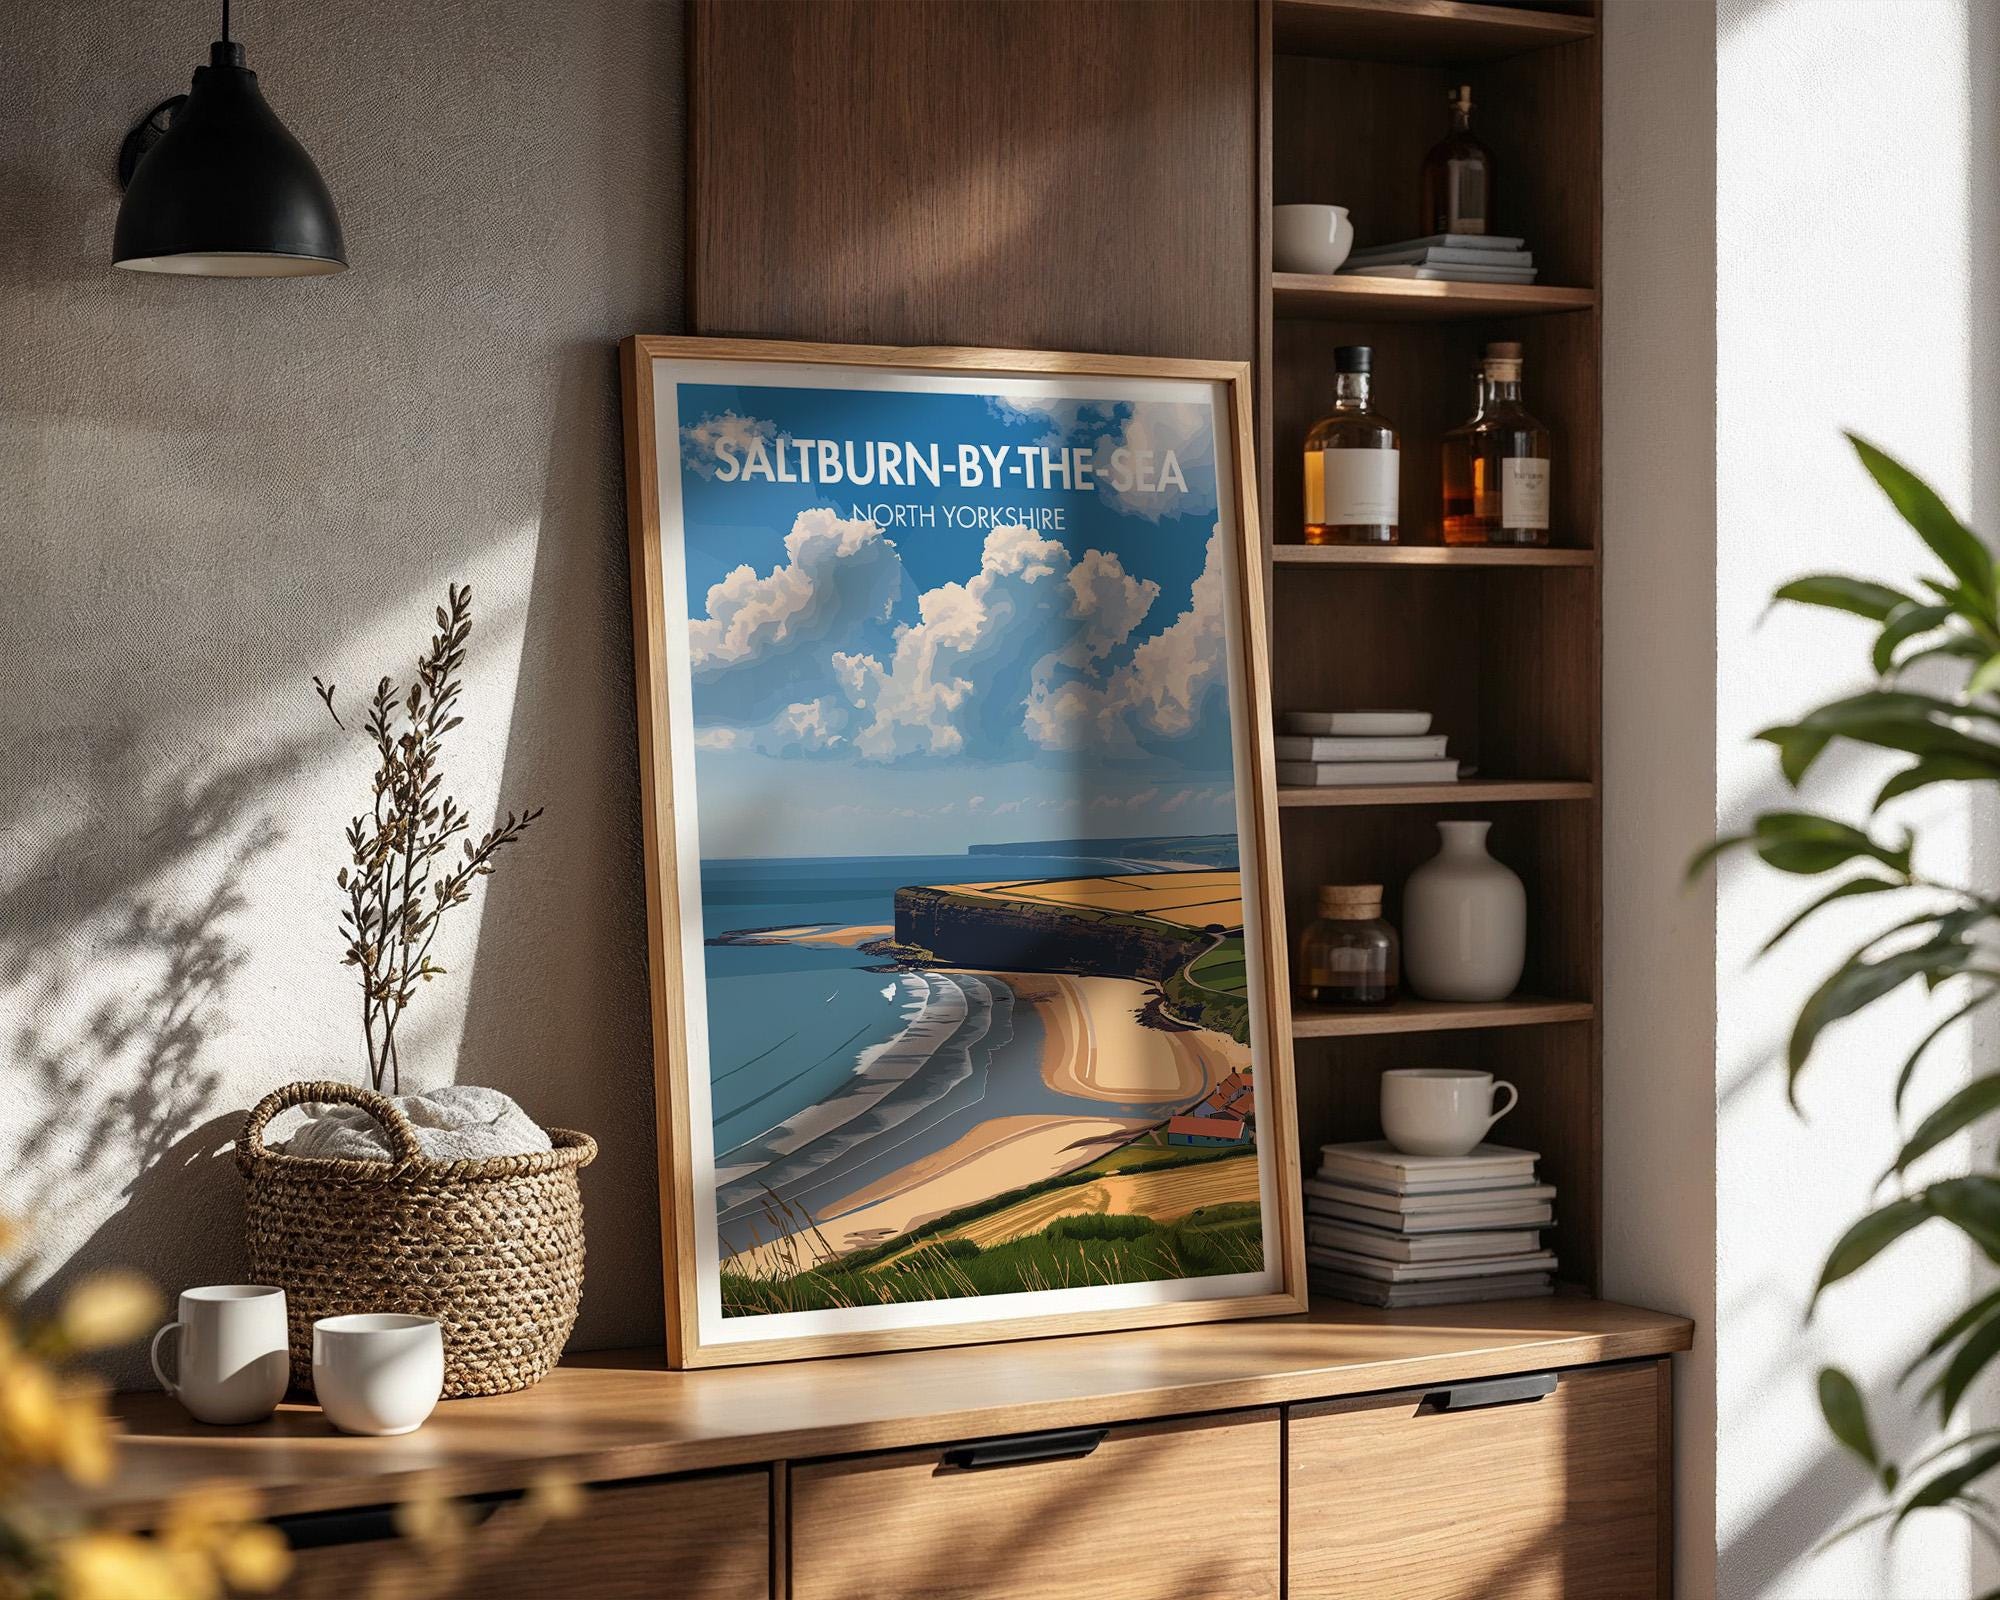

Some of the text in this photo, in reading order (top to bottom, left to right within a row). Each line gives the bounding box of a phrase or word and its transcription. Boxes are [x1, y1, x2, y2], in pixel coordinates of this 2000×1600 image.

[714, 436, 1188, 493] SALTBURN-BY-THE-SEA
[852, 503, 1066, 530] NORTH YORKSHIRE
